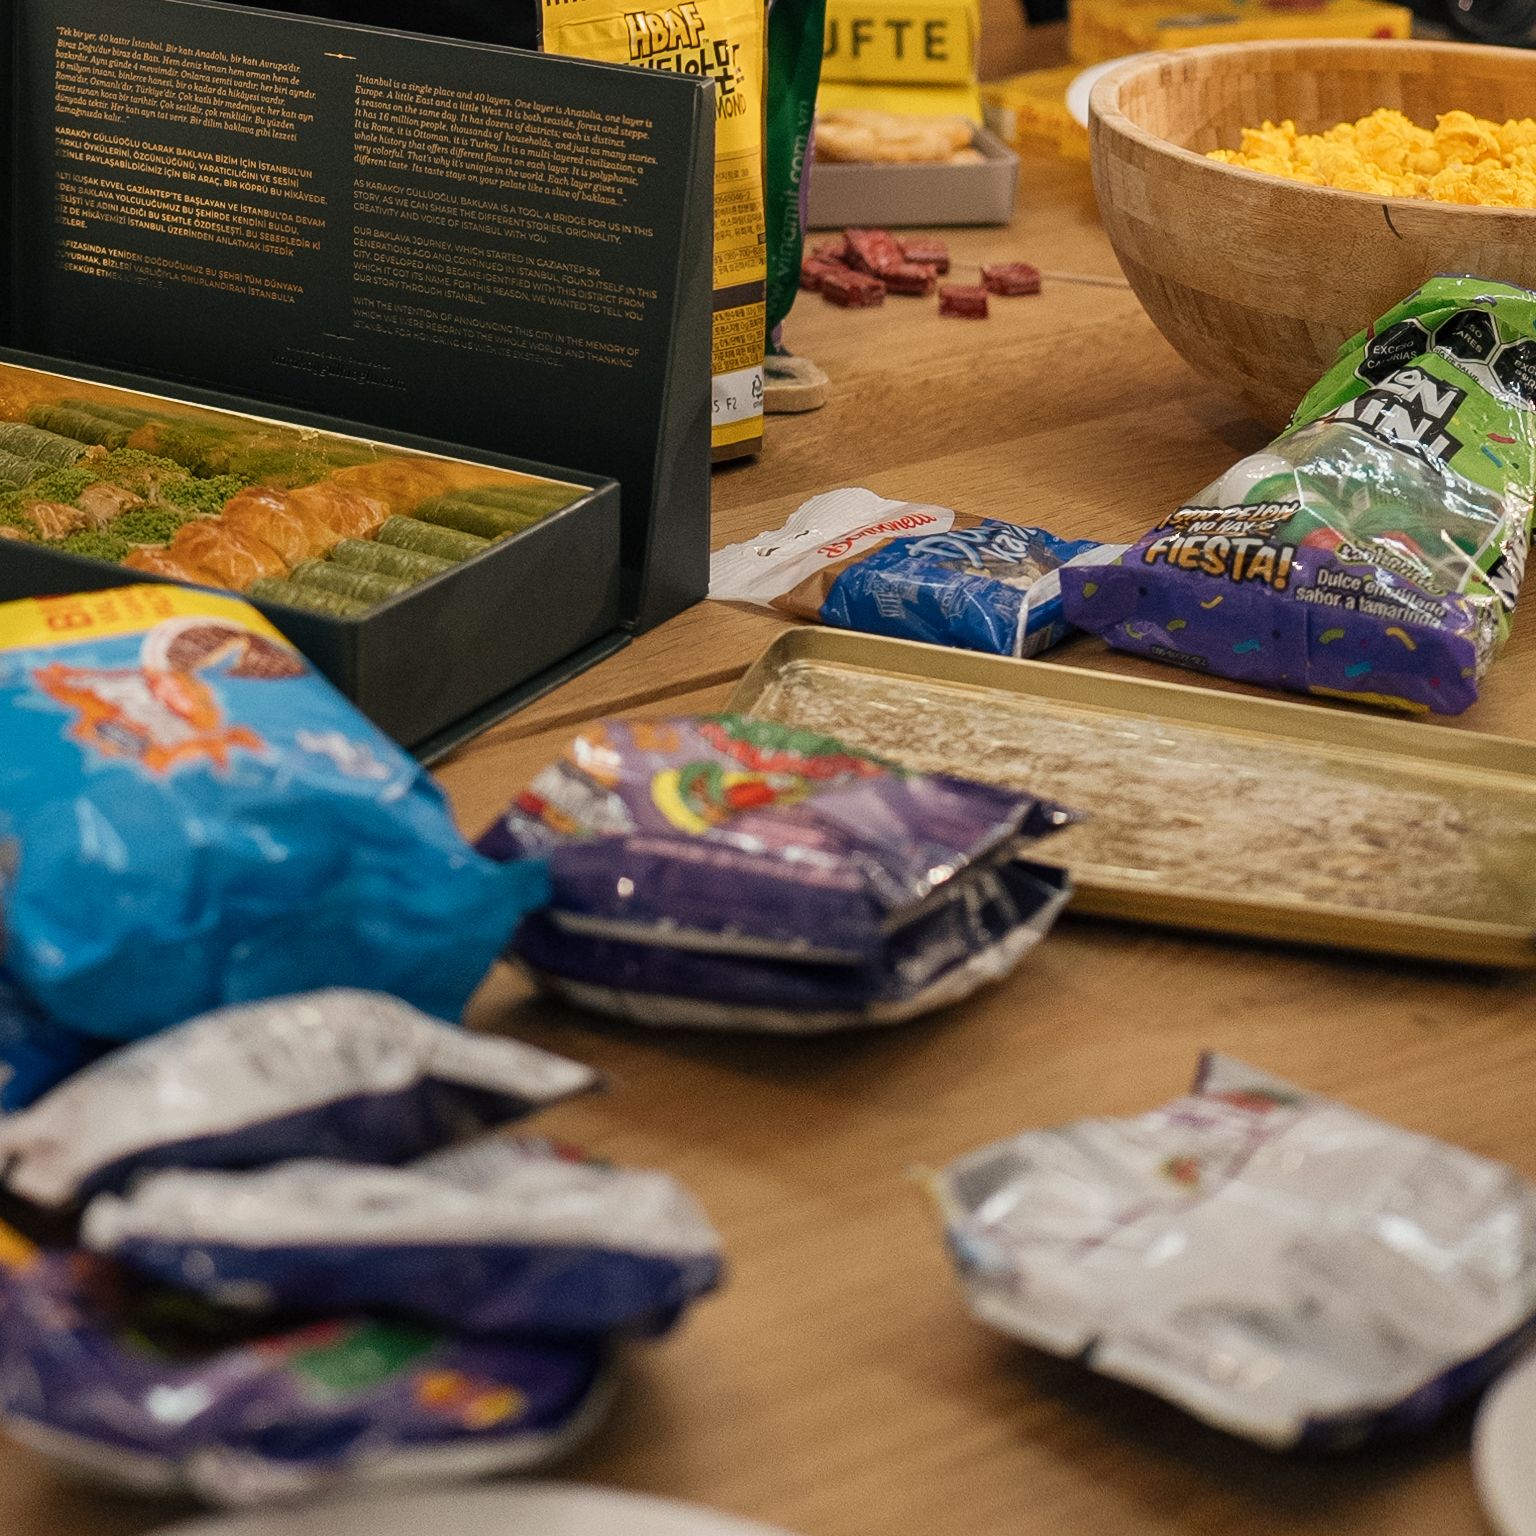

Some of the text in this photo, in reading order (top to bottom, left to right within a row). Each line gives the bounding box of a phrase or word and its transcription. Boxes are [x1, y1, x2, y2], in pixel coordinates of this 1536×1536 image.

[624, 1, 705, 60] HBAF
[408, 82, 433, 95] single
[433, 86, 455, 98] place
[532, 101, 554, 114] layer
[622, 114, 645, 128] layer
[354, 131, 378, 143] whole
[378, 134, 407, 149] history
[408, 139, 426, 151] that
[426, 143, 449, 154] offers
[449, 146, 484, 160] different
[484, 152, 513, 165] flavors
[526, 160, 546, 170] each
[390, 114, 419, 127] million
[450, 123, 492, 138] thousands
[571, 145, 589, 154] just
[601, 149, 627, 162] many
[1188, 520, 1255, 534] NO HAY
[1144, 534, 1294, 590] FIESTA!
[1316, 568, 1363, 592] Dulce
[1295, 586, 1344, 607] sabor
[1345, 595, 1357, 611] a
